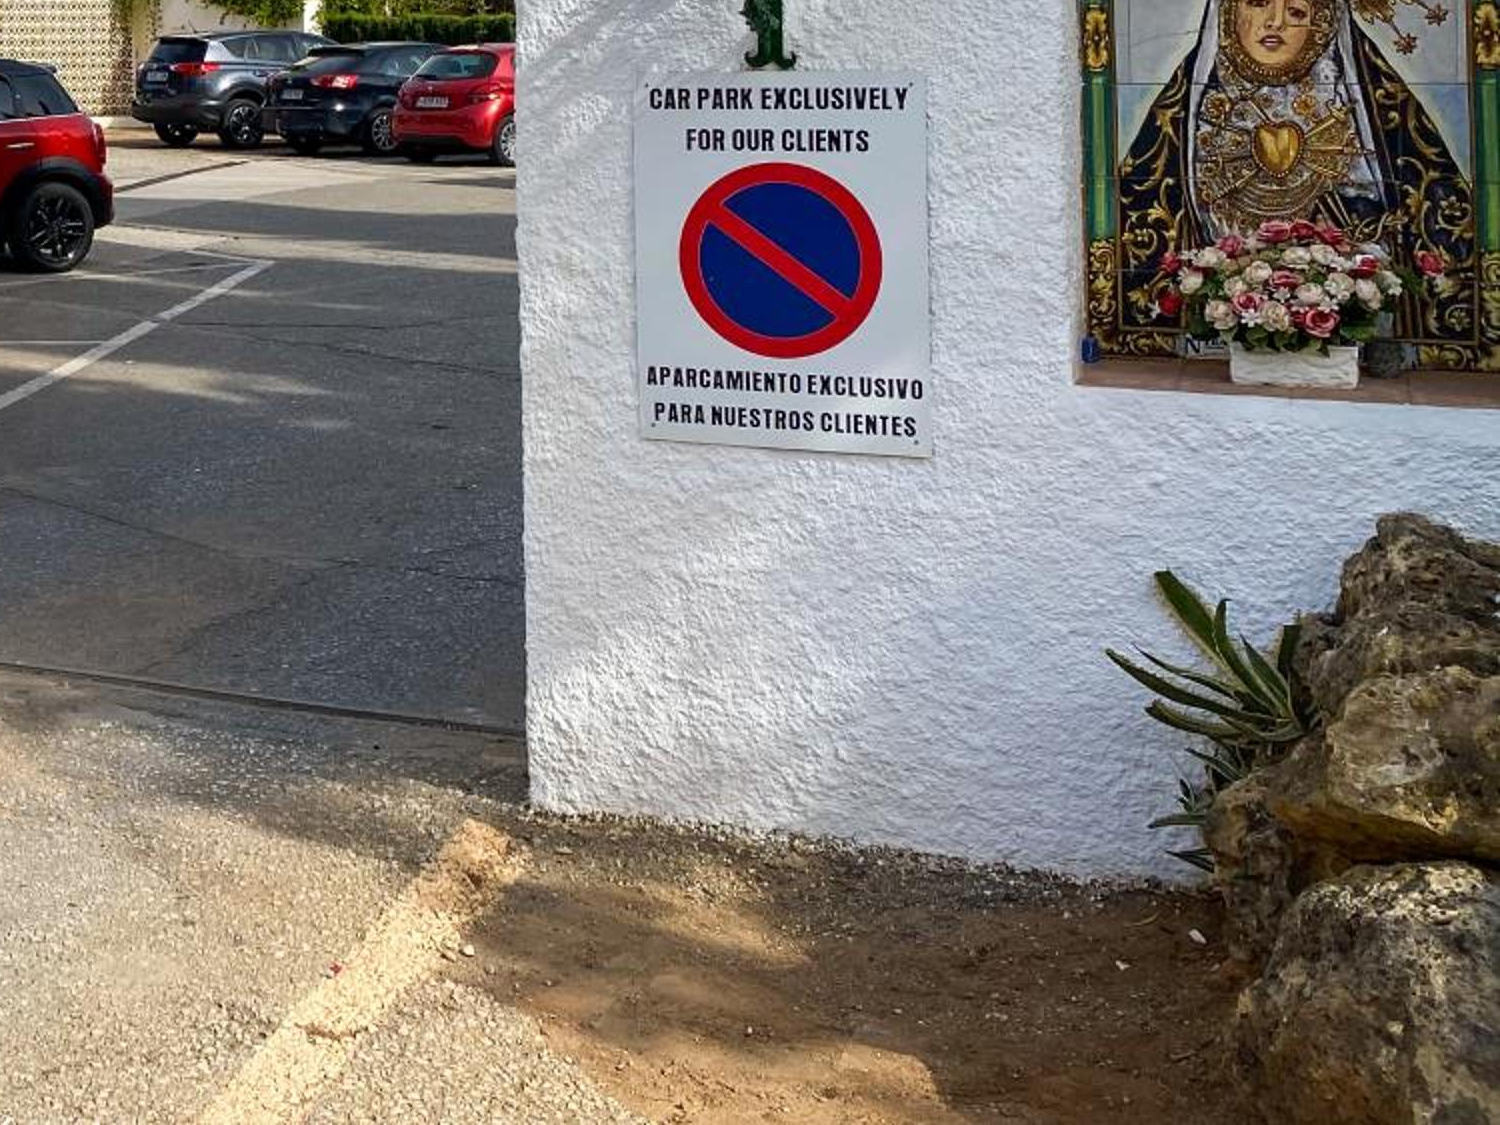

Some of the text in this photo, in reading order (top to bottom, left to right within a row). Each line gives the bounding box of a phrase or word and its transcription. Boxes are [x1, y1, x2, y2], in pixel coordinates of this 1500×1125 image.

[649, 87, 908, 110] CAR PARK EXCLUSIVELY
[685, 128, 870, 152] FOR OUR CLIENTS
[647, 366, 923, 400] APARCAMIENTO EXCLUSIVO
[654, 402, 917, 437] PARA NUESTROS CLIENTES
